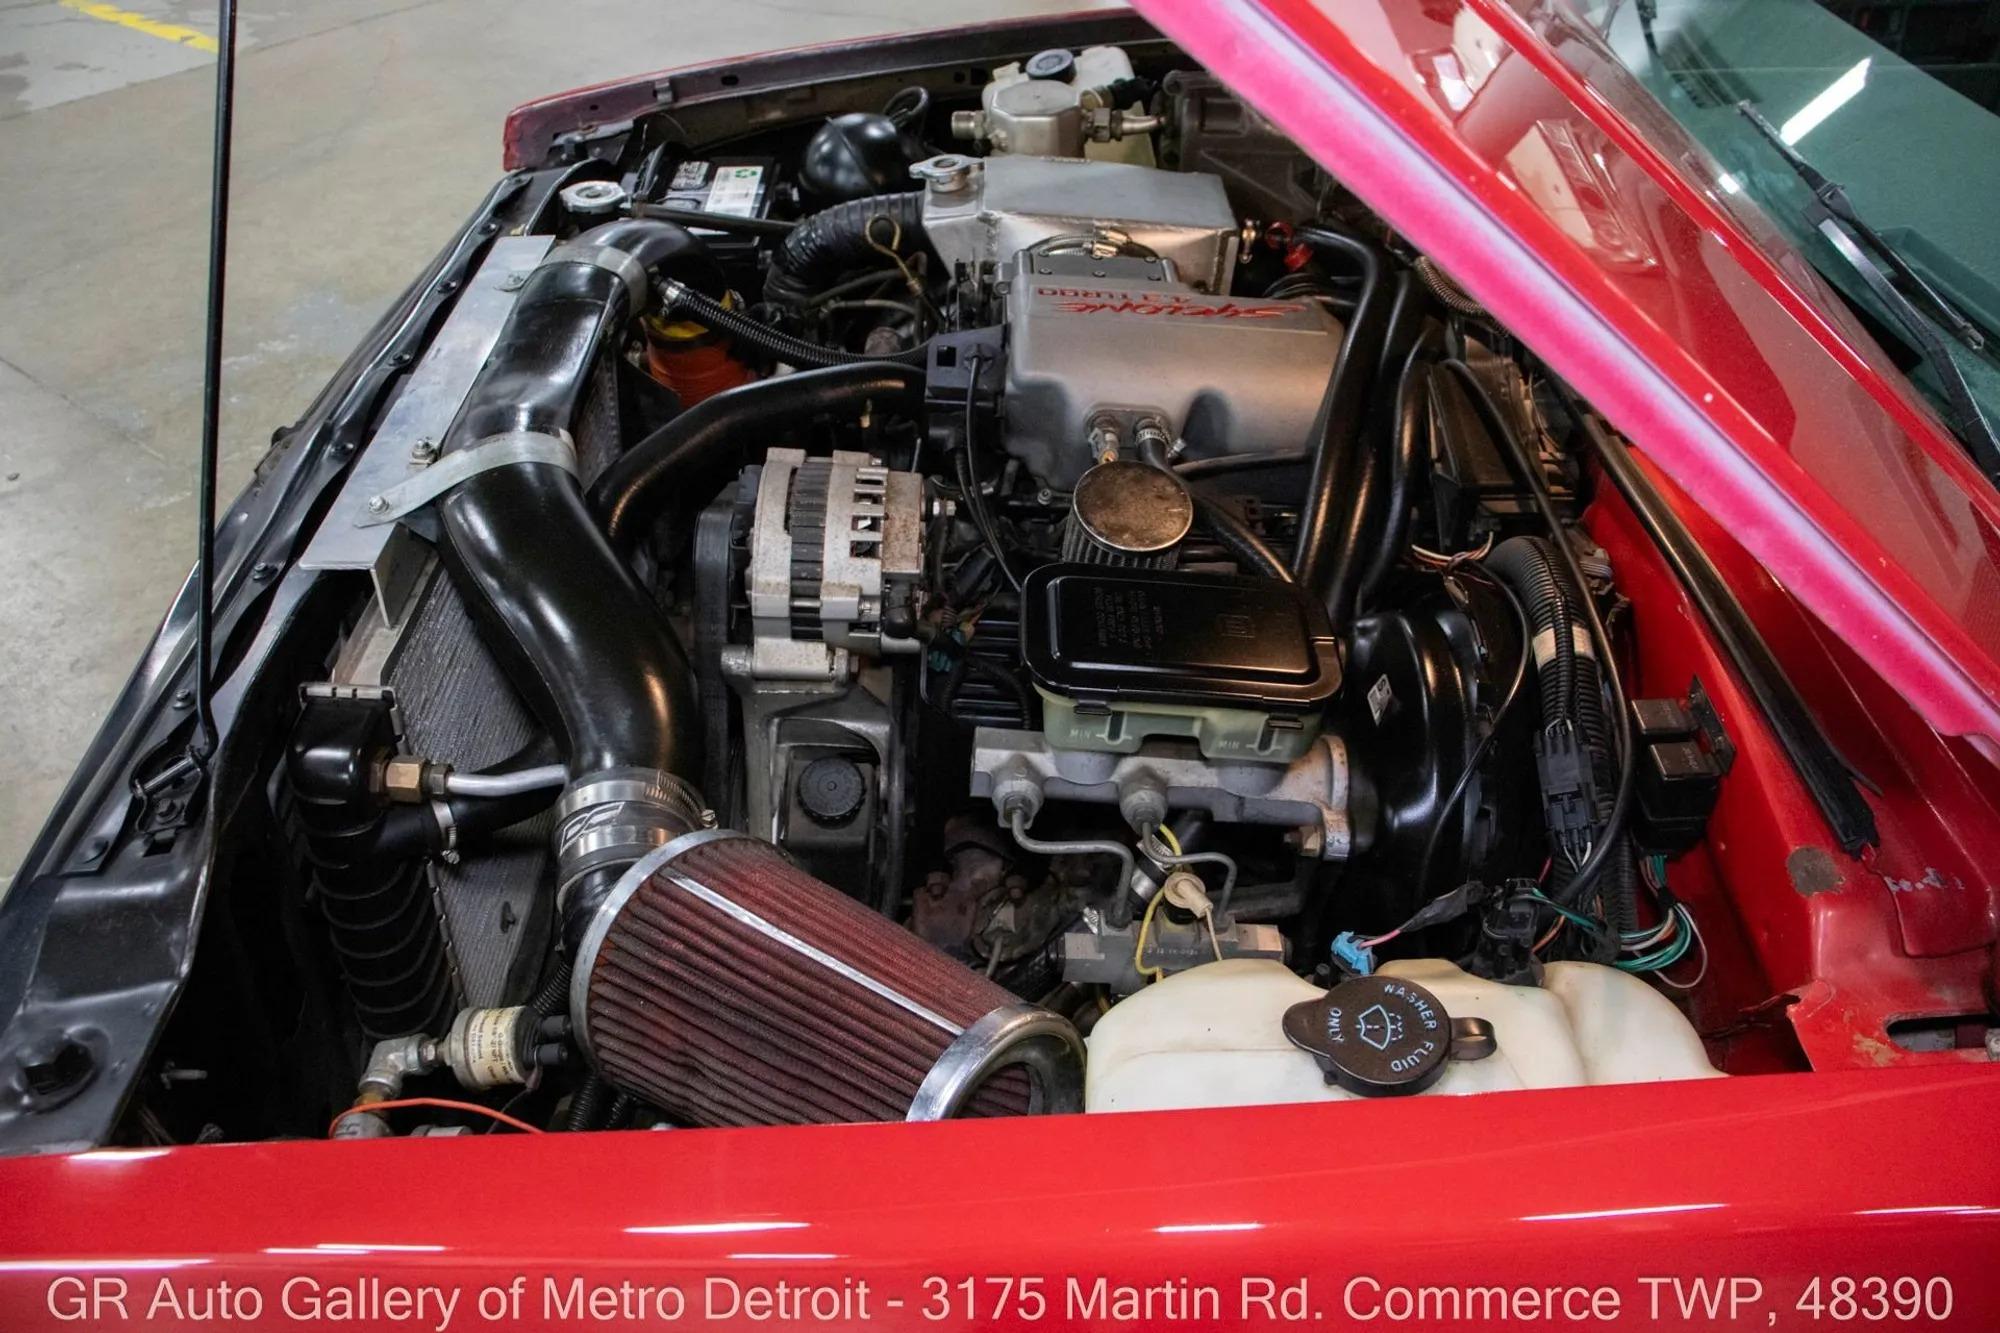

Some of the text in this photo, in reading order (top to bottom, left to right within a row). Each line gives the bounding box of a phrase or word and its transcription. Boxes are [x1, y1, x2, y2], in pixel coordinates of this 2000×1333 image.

[1069, 728, 1091, 739] MIN
[1327, 1006, 1345, 1044] ONLY
[1384, 983, 1438, 1073] WASHER FLUID
